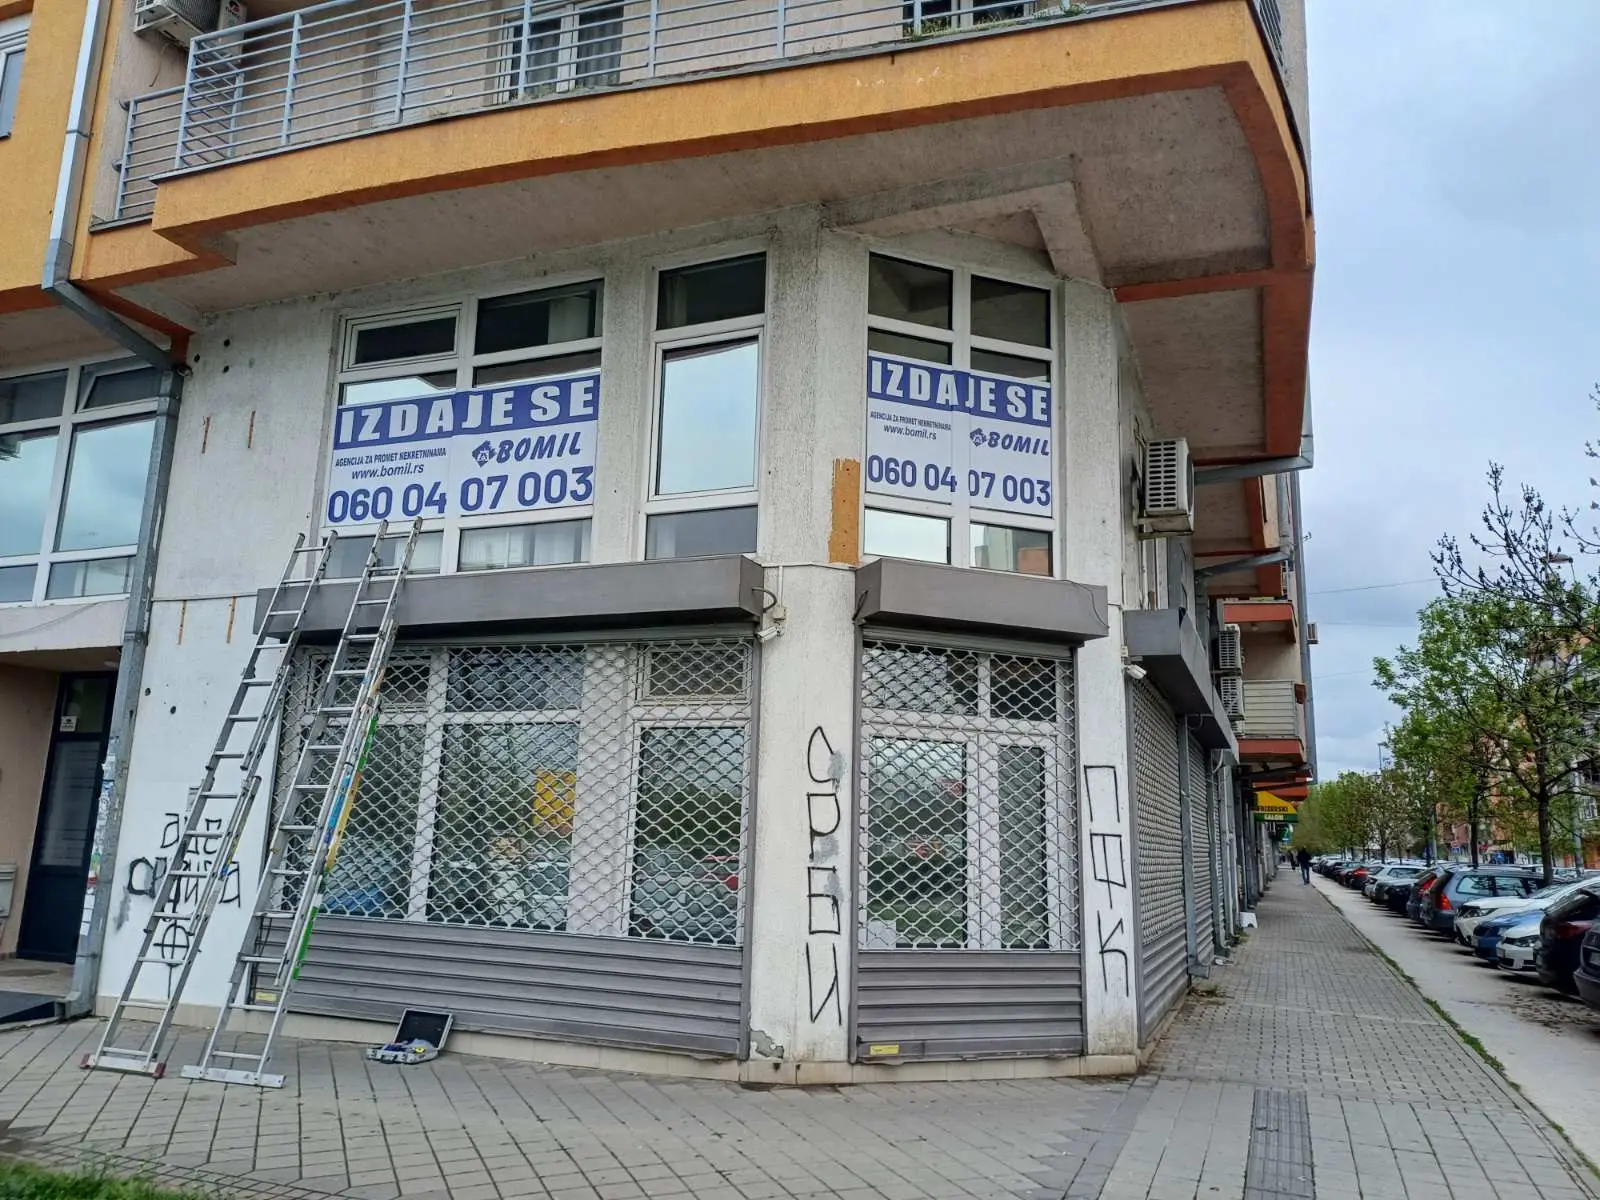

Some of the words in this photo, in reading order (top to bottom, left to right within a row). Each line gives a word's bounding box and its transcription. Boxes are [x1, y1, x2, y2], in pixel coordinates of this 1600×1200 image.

[871, 360, 997, 413] IZDAJE
[1006, 385, 1048, 422] SE
[339, 391, 514, 444] IZDAJE
[530, 380, 594, 422] SE
[496, 431, 581, 465] BOMIL
[883, 424, 937, 440] www.bomil.rs
[987, 431, 1050, 456] BOMIL
[335, 455, 364, 467] AGENCIJA
[365, 455, 373, 464] ZA
[373, 452, 398, 463] PROMET
[399, 447, 447, 461] NEKRETNINAMA
[352, 462, 424, 480] www.bomil.rs
[328, 486, 393, 523] 060
[402, 481, 447, 517] 04
[460, 474, 508, 511] 07
[518, 465, 594, 506] 003
[868, 455, 917, 488] 060
[924, 464, 958, 493] 04
[968, 469, 996, 498] 07
[1002, 475, 1051, 506] 003
